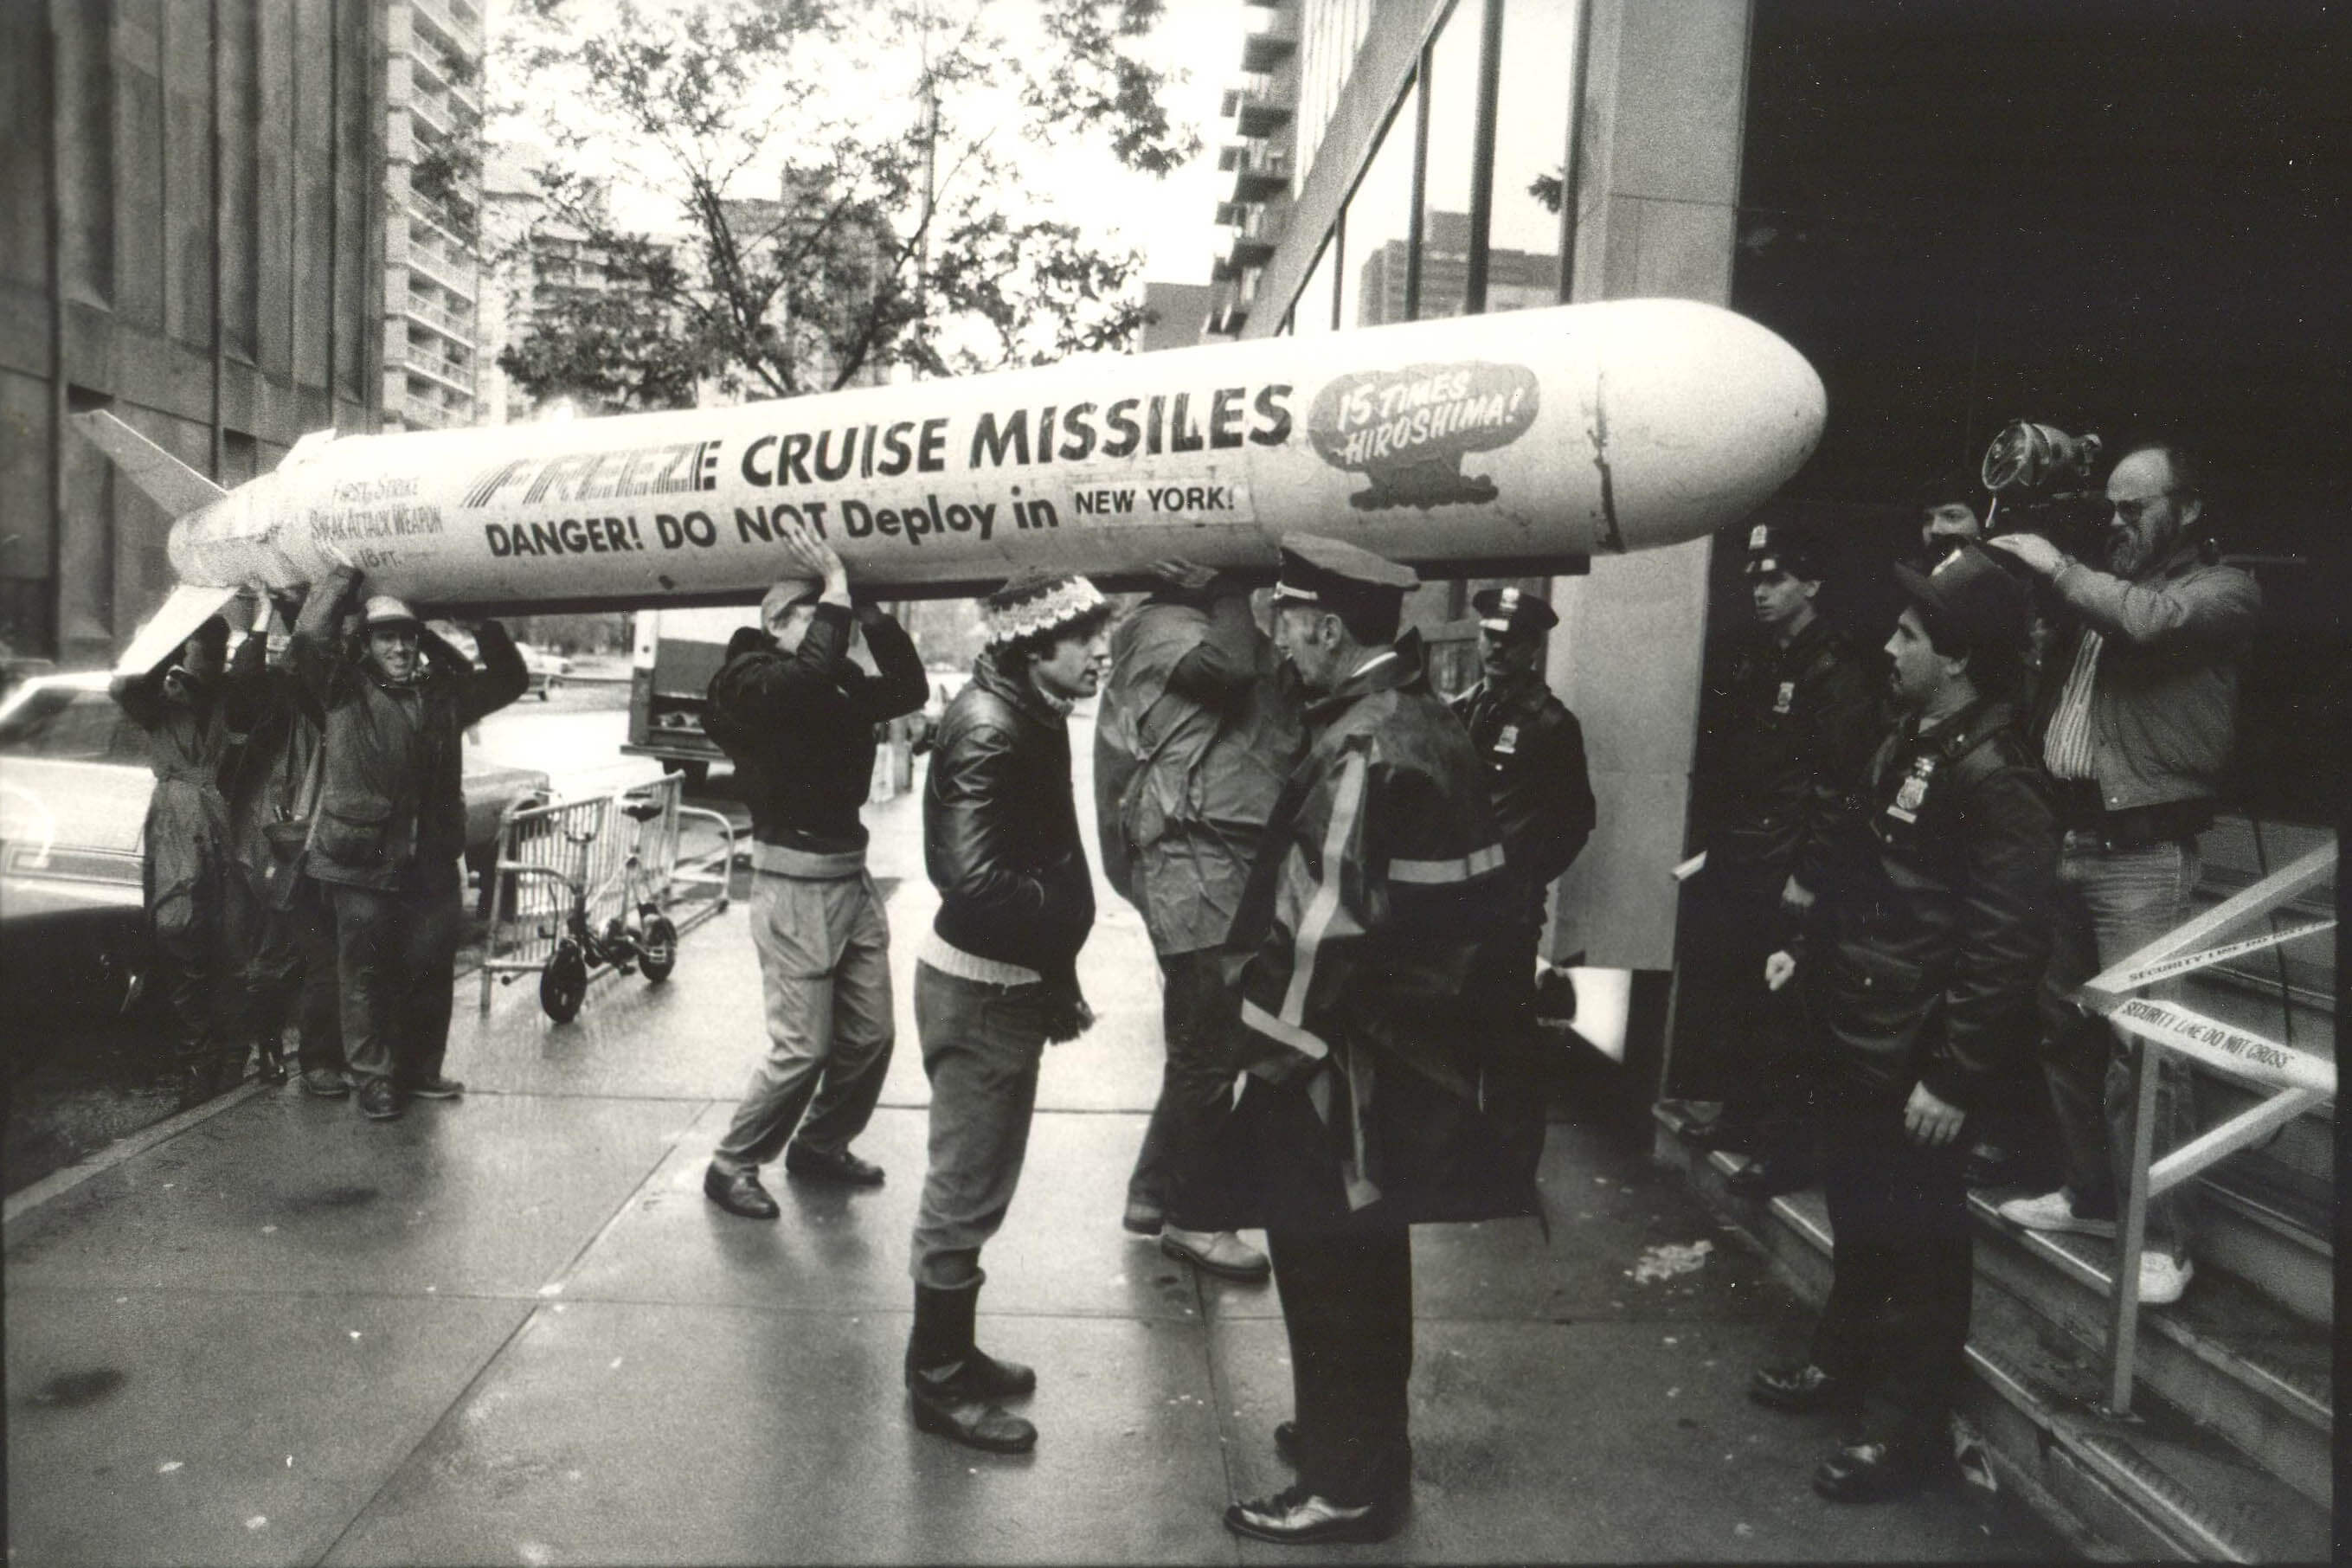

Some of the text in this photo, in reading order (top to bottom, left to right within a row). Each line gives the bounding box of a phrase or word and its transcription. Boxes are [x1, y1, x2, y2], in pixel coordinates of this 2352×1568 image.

[1336, 387, 1524, 465] HIROSHIMA!
[1338, 369, 1471, 432] 15 TIMES
[459, 383, 1294, 509] FREEZE CRUISE MISSILES
[485, 484, 1235, 557] DANGER! DO NOT Deploy in NEW YORK!
[2129, 954, 2203, 981] SECURITY
[2122, 1001, 2296, 1070] SECURITY LINE DO NOT CROSS
